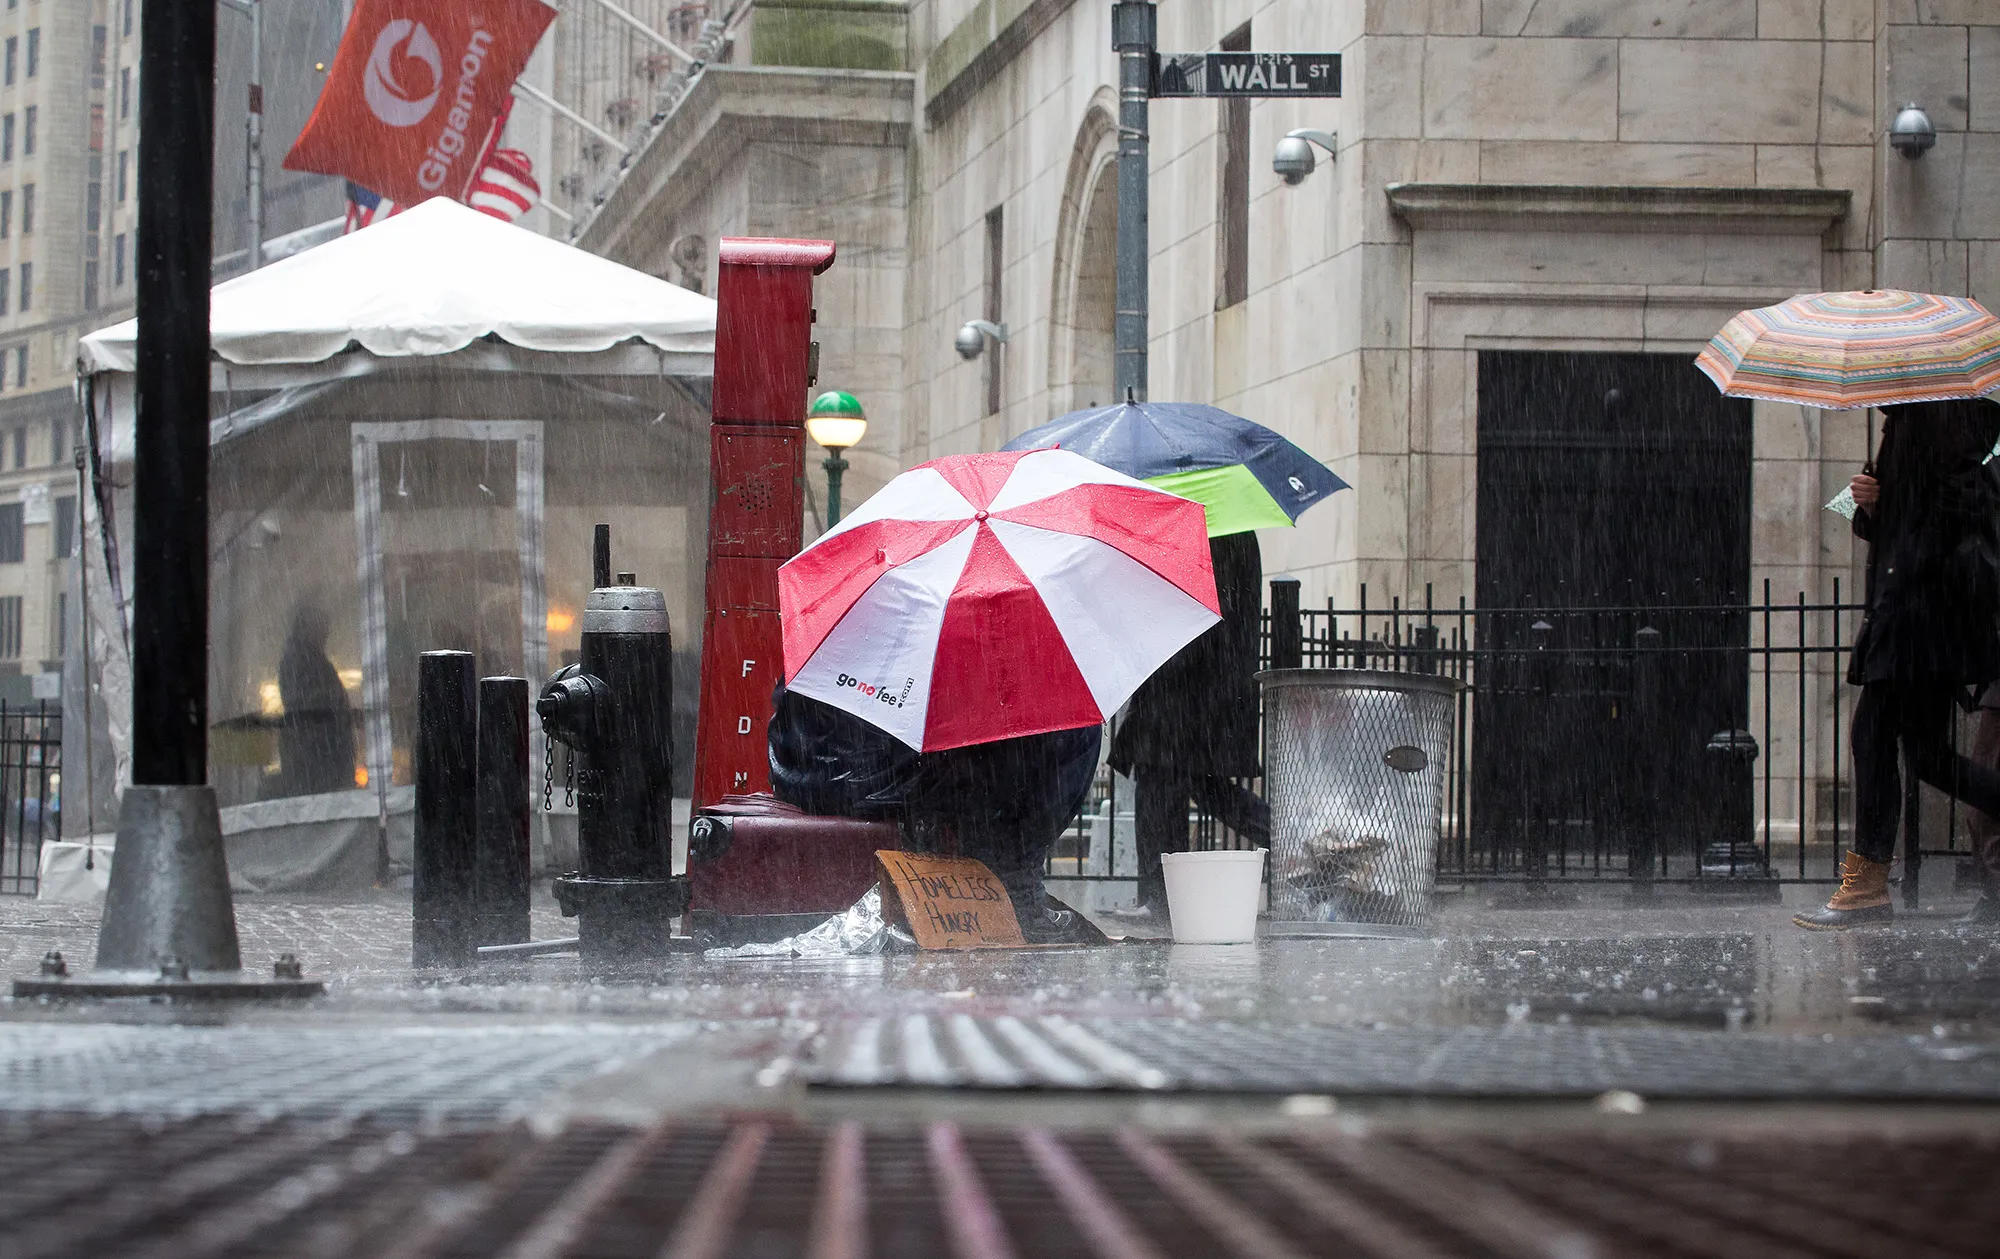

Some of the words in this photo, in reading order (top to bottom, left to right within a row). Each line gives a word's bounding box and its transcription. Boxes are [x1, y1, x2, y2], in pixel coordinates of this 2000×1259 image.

[1220, 64, 1308, 90] WALL
[1310, 64, 1330, 78] ST
[418, 30, 494, 190] Gigamon
[894, 859, 1001, 902] HOMELESS
[923, 901, 982, 935] HUNGRY
